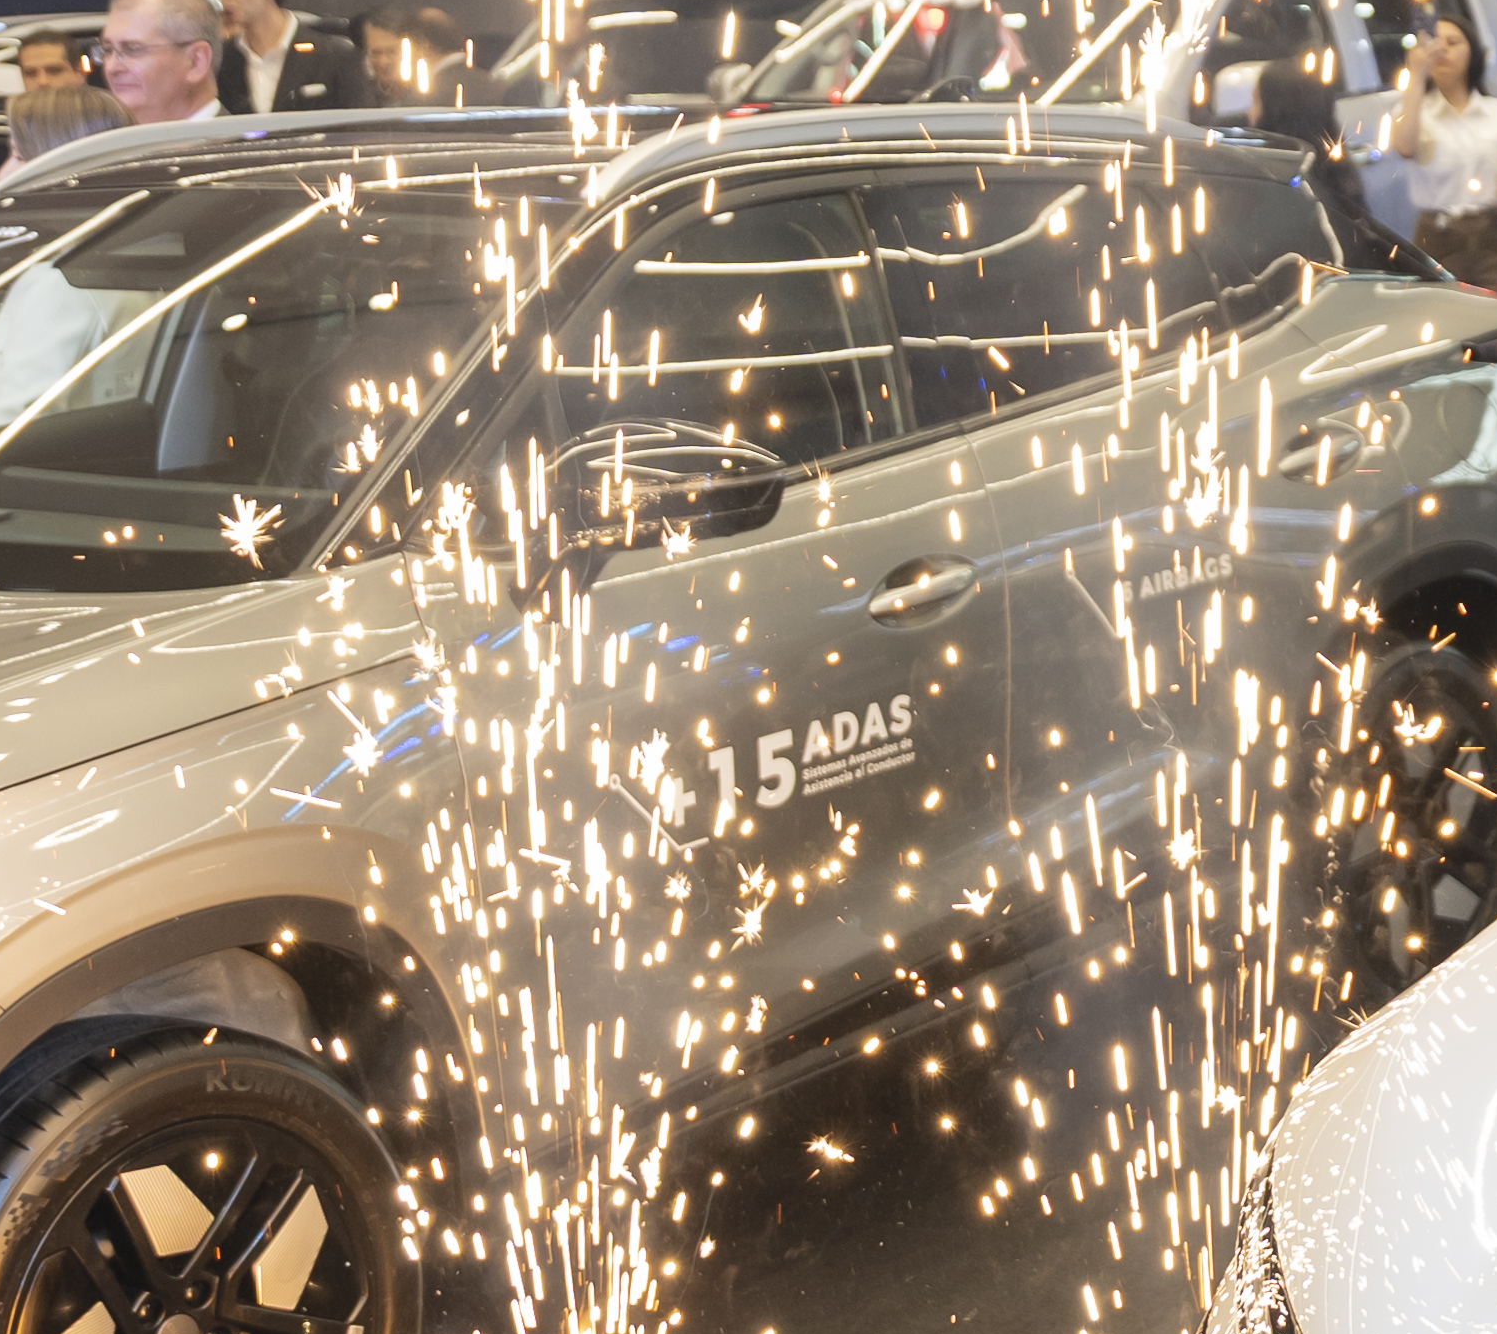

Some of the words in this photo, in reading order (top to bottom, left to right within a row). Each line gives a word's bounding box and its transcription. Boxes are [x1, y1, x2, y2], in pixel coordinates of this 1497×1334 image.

[1139, 553, 1234, 599] AIRBAGS
[802, 693, 912, 764] ADAS
[802, 758, 848, 781] Sistemas
[848, 742, 899, 767] Avanzados
[899, 736, 914, 750] de
[802, 768, 854, 797] Asistencia
[854, 761, 866, 779] al
[866, 751, 917, 775] Conductor
